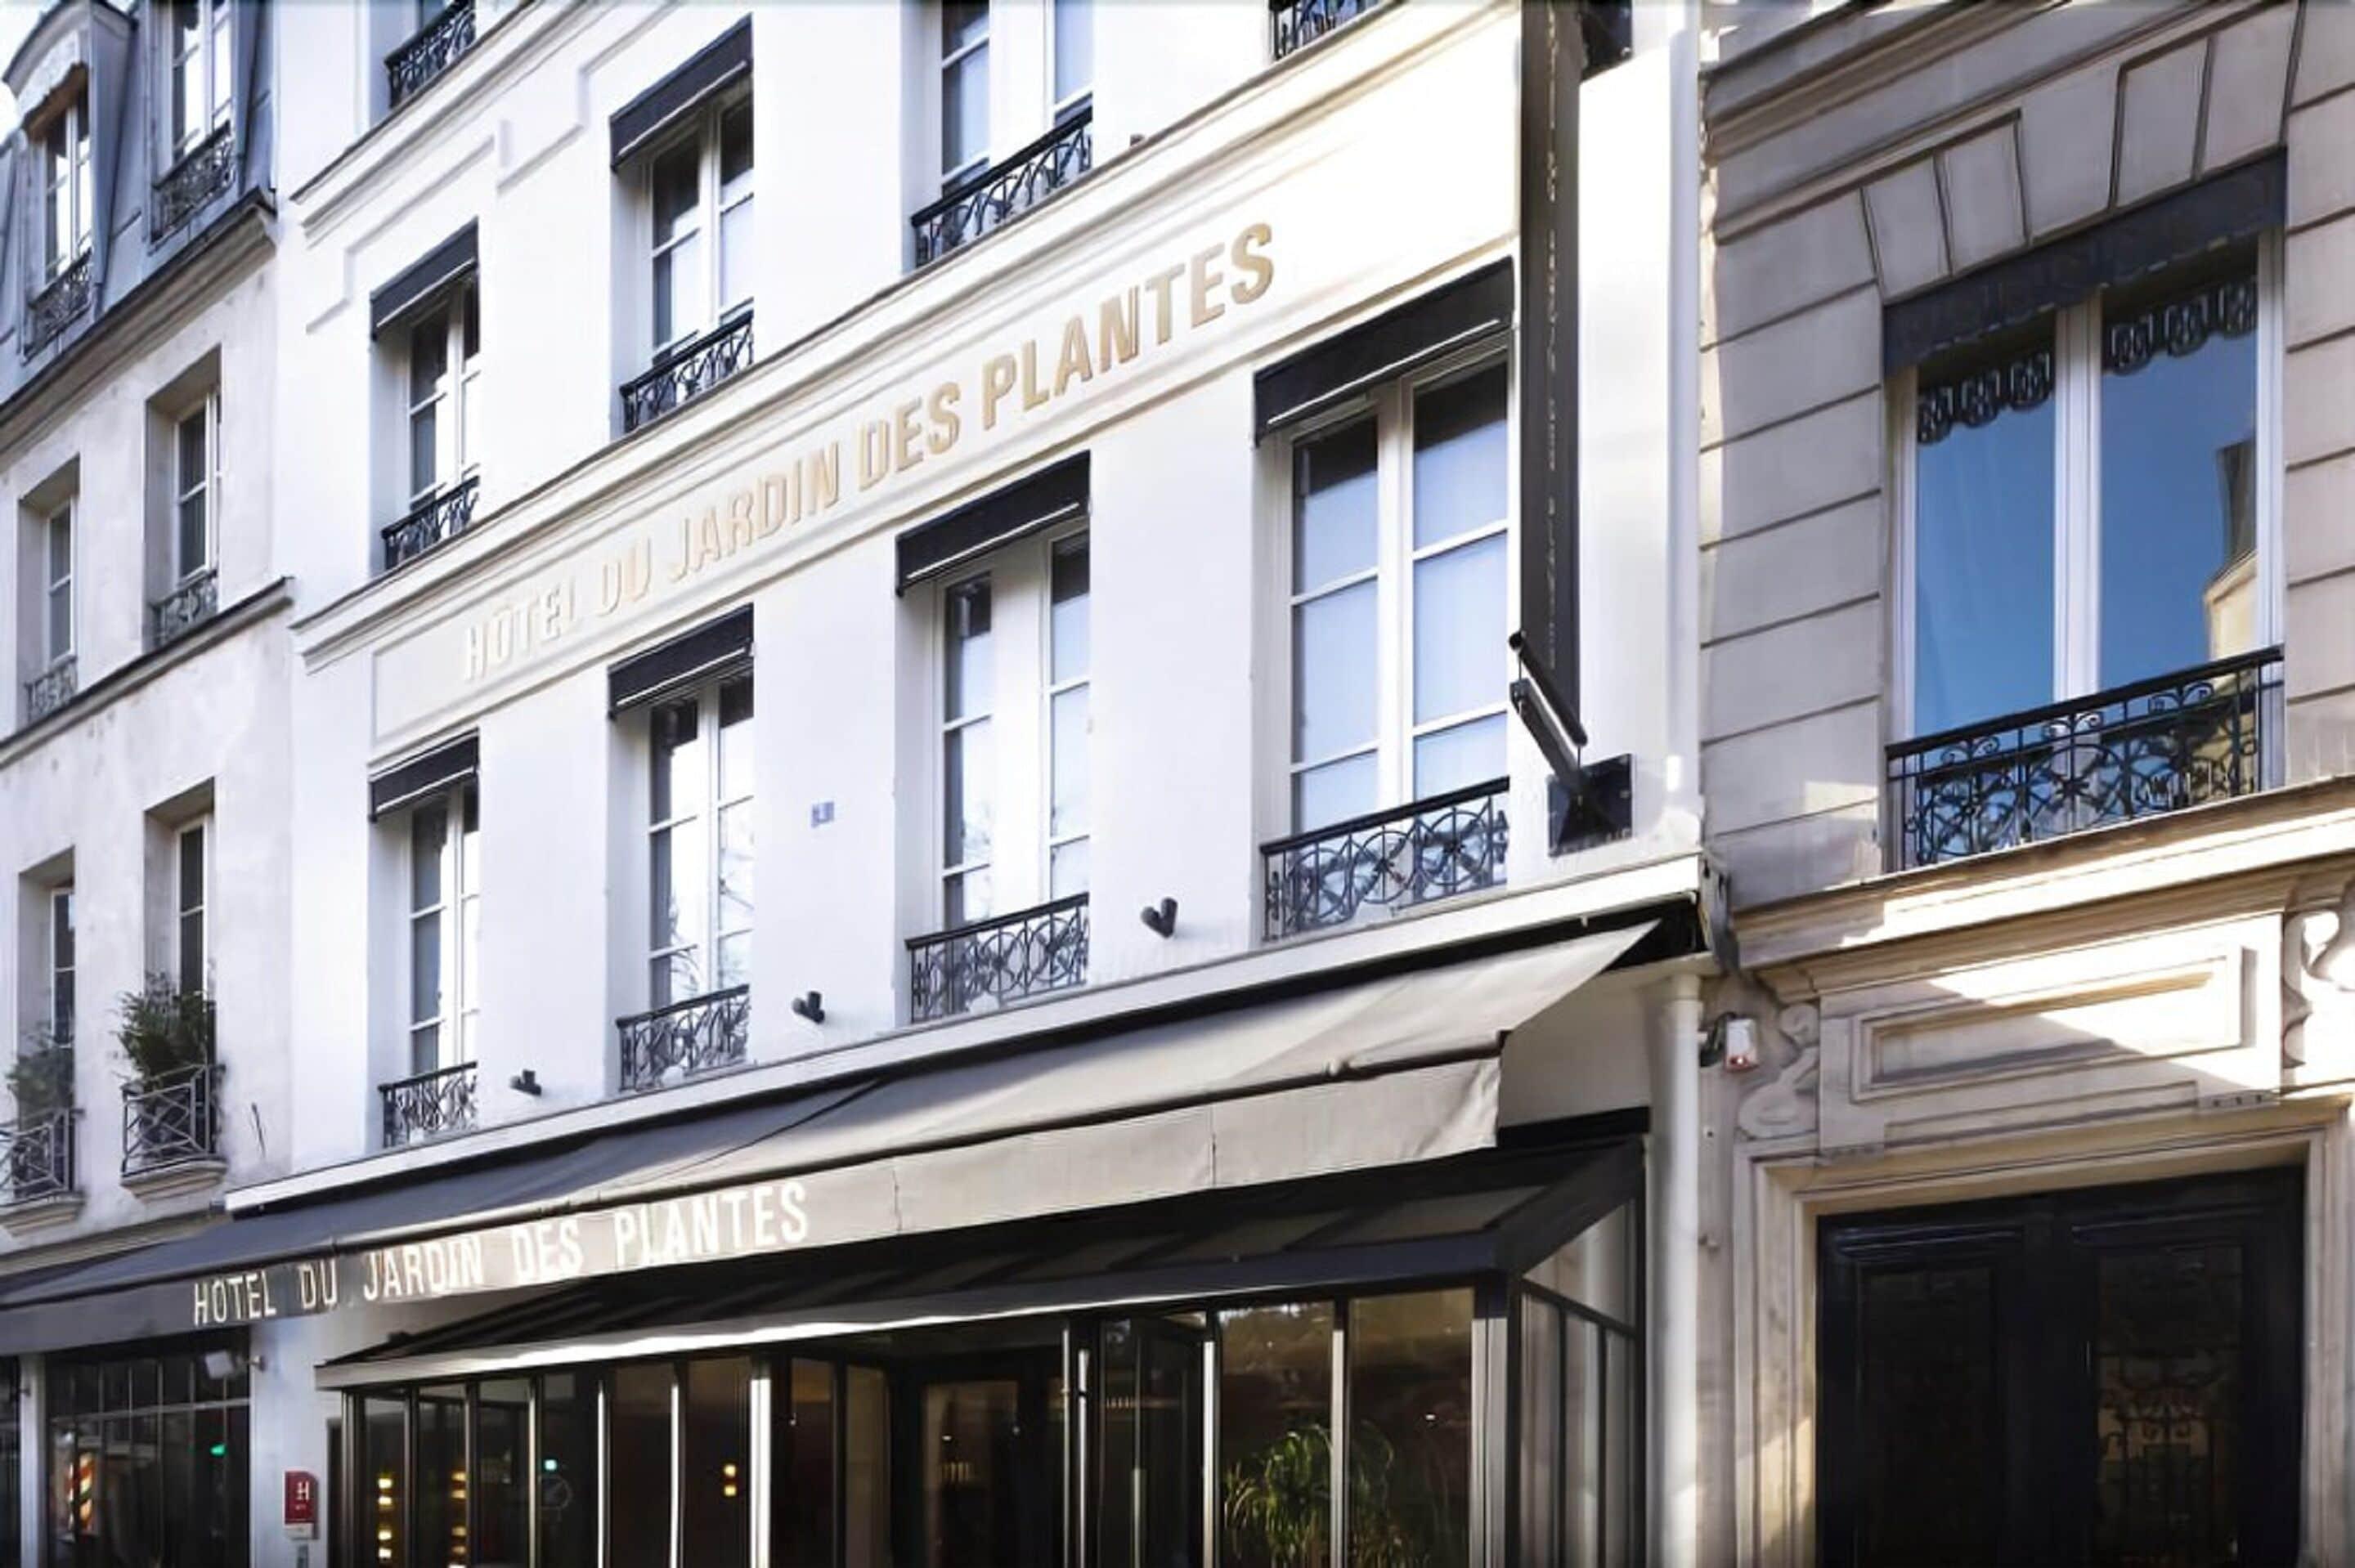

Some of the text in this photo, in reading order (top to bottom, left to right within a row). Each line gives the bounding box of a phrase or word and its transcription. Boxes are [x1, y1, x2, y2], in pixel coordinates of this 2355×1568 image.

[596, 535, 652, 617] DU
[670, 440, 840, 582] JARDIN
[858, 381, 962, 491] DES
[981, 222, 1275, 431] PLANTES
[298, 1257, 339, 1310] DU
[363, 1235, 485, 1301] JARDIN
[510, 1216, 584, 1285] DES
[613, 1180, 810, 1269] PLANTES
